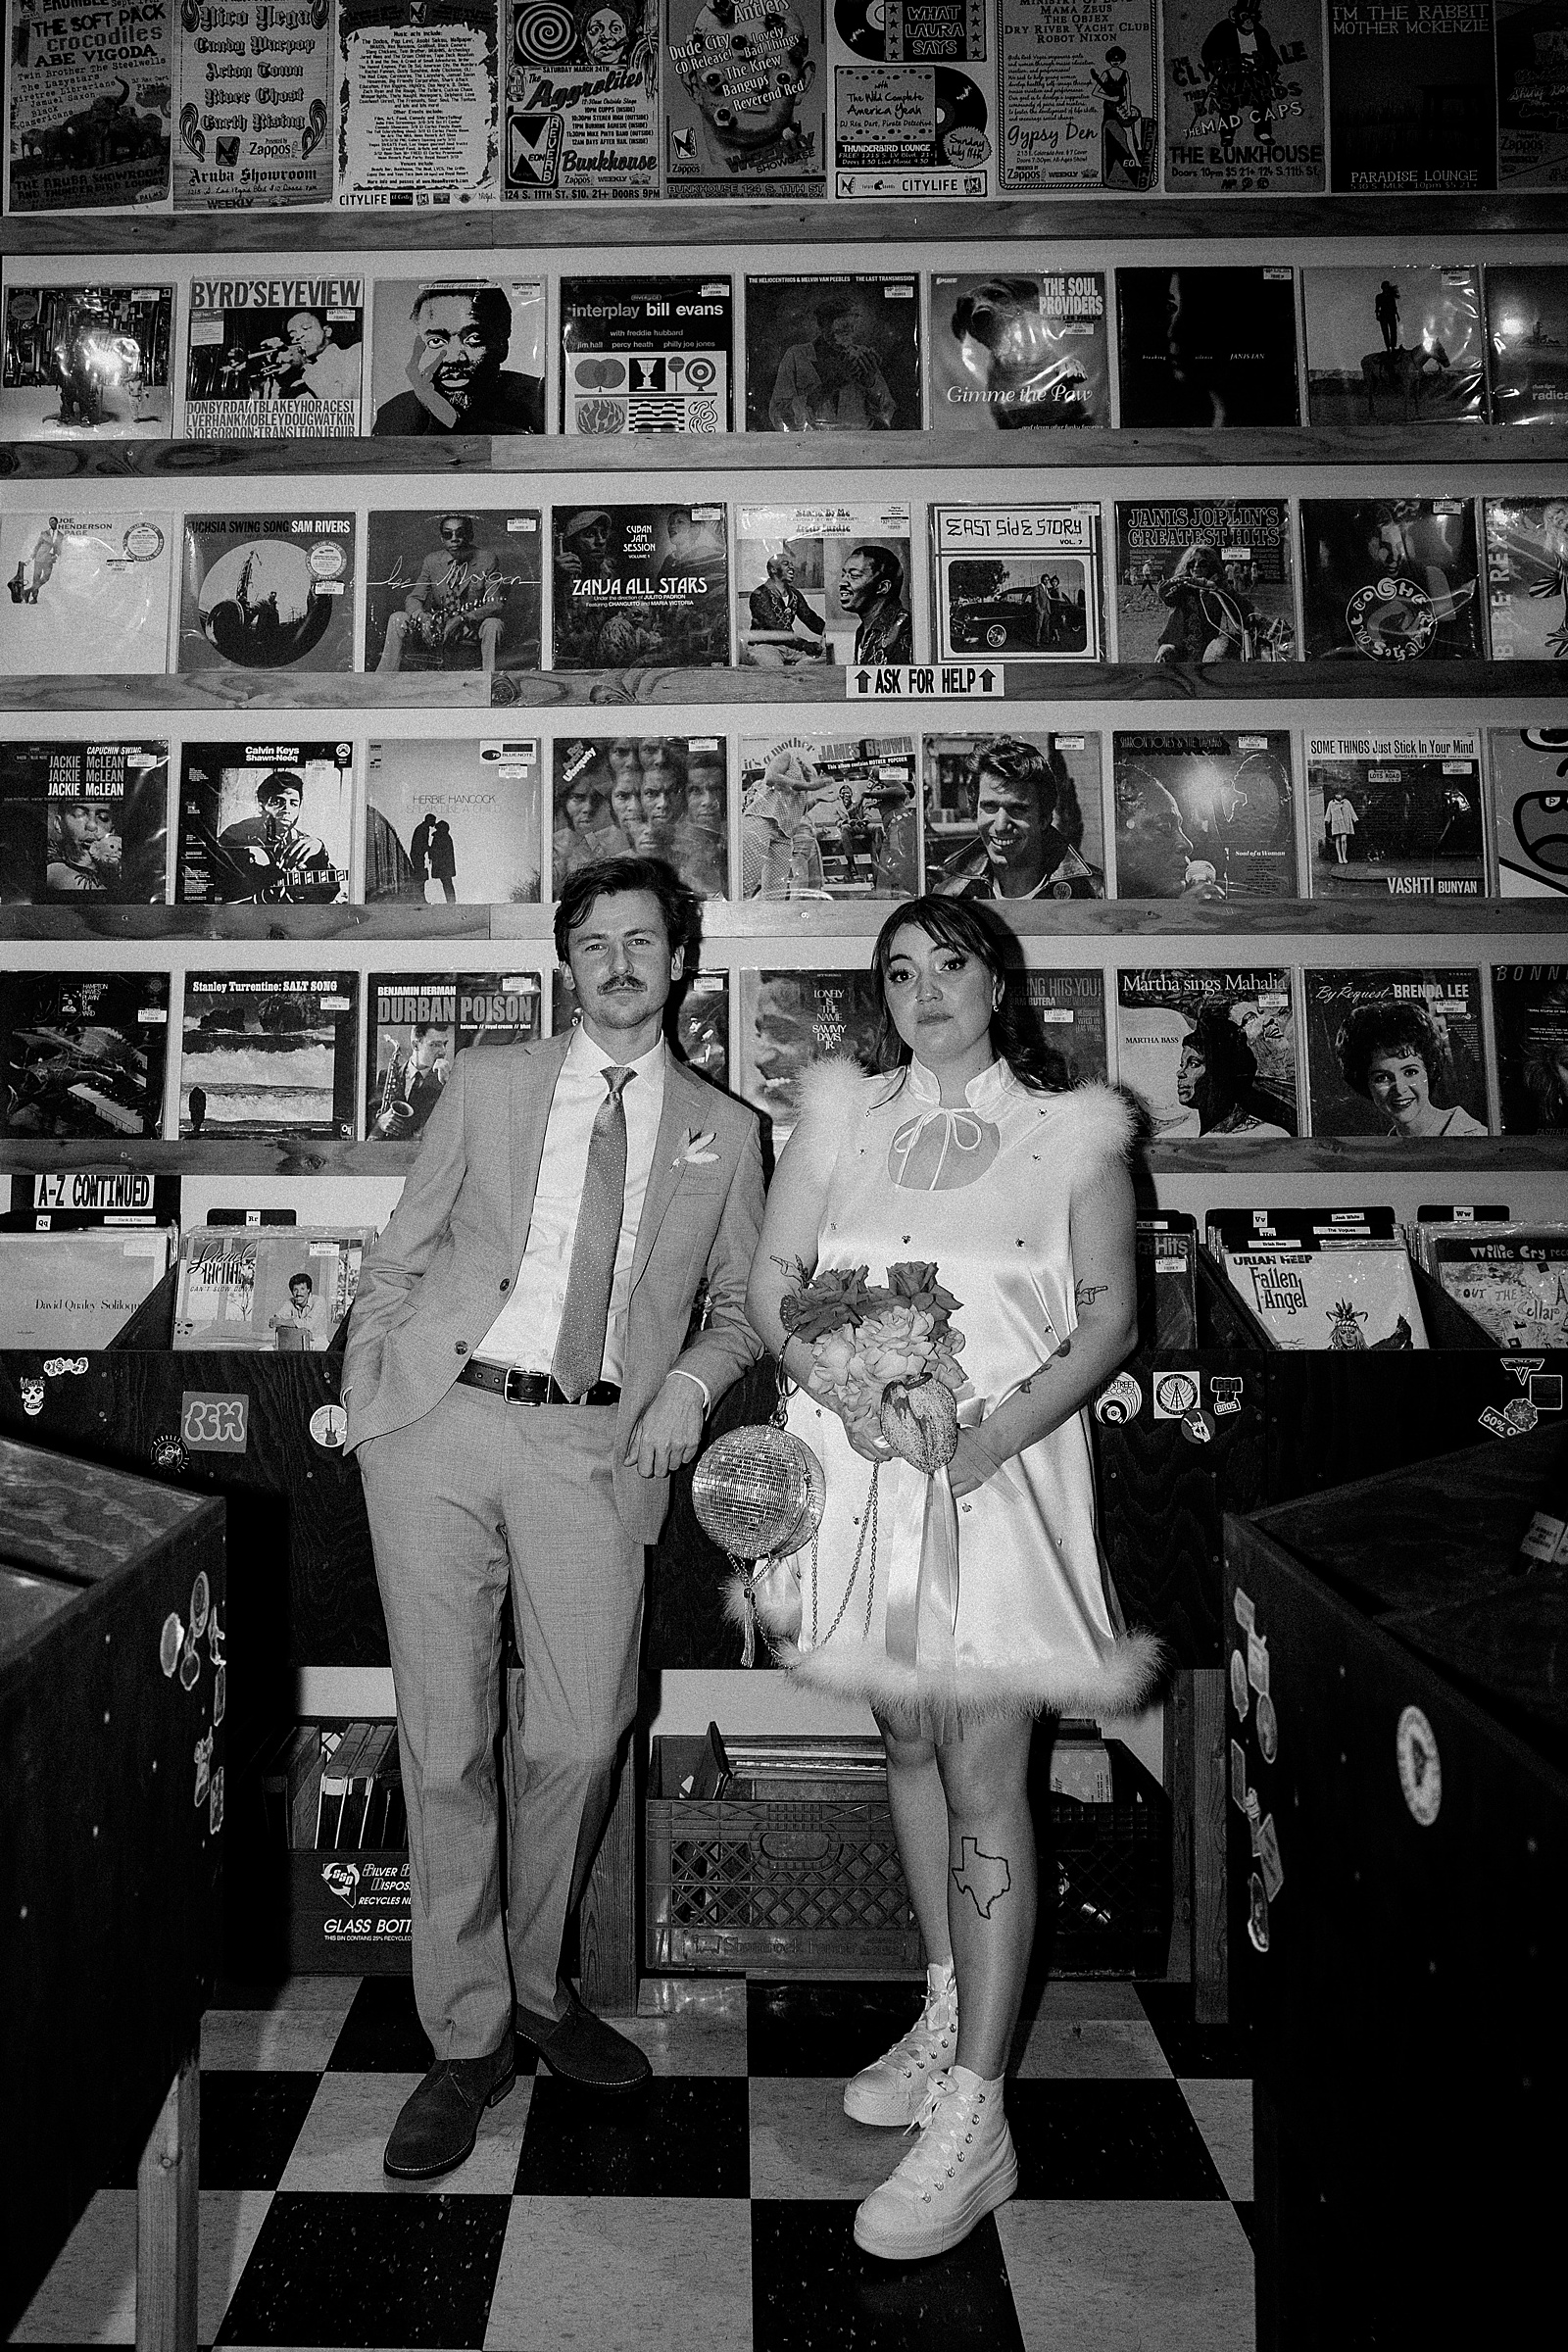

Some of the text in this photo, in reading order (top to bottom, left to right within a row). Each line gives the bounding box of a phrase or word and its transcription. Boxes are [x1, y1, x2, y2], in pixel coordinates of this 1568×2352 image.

[31, 3, 166, 37] THE SOFT PACK
[734, 0, 790, 24] Antlers
[907, 5, 961, 21] WHAT
[1332, 4, 1490, 21] I'M THE RABBIT
[752, 26, 784, 44] Lovely
[905, 23, 965, 38] LAURA
[1004, 23, 1150, 34] DRY RIVER YACHT CLUB
[1333, 21, 1399, 35] MOTHER
[47, 25, 163, 52] crocodiles
[744, 34, 800, 58] Bad Things
[1037, 33, 1117, 43] ROBOT NIXON
[668, 33, 730, 61] Dude City
[912, 40, 957, 55] SAYS
[34, 44, 158, 68] ABE VIGODA
[674, 62, 689, 74] CD
[725, 55, 782, 80] The Knew
[722, 74, 769, 97] Bangups
[733, 80, 805, 112] Reverend Red
[847, 90, 924, 104] The Wild Complete
[847, 103, 921, 120] America Yeah
[1200, 101, 1303, 135] MAD CAPS
[949, 133, 984, 152] Sunday
[1007, 122, 1098, 149] Gypsy Den
[249, 142, 291, 158] Zappos
[1169, 145, 1323, 165] THE BUNKHOUSE
[562, 149, 658, 172] Bunkhouse
[756, 149, 815, 173] SHOWCASE
[189, 169, 317, 186] Aruba Showroom
[1350, 170, 1478, 182] PARADISE LOUNGE
[902, 179, 957, 191] CITYLIFE
[339, 194, 387, 206] CITYLIFE
[504, 190, 518, 200] 124
[190, 280, 362, 308] BYRD'SEYEVIEW
[1043, 277, 1098, 296] THE SOUL
[572, 303, 724, 319] interplay bill evans
[1039, 296, 1103, 315] PROVIDERS
[947, 383, 1093, 403] Gimme the Paw
[1128, 507, 1280, 527] JANIS JOPLIN'S
[228, 519, 351, 533] SWING SONG SAM RIVERS
[946, 517, 1082, 537] EAST STORY
[1128, 527, 1281, 547] GREATEST HITS
[572, 577, 708, 596] ZANJA ALL STARS
[874, 667, 976, 694] ASK FOR HELP
[245, 746, 300, 757] Calvin Keys
[1310, 740, 1474, 754] SOME THINGS Just Stick In Your Mind
[49, 756, 80, 768] JACKIE
[49, 769, 80, 782] JACKIE
[48, 783, 80, 796] JACKIE
[1387, 877, 1477, 894] VASHTI BUNYAN
[193, 981, 338, 993] Stanley Turrentine: SALT SONG
[377, 986, 457, 996] BENJAMIN HERMAN
[1123, 972, 1288, 996] Martha sings Mahalia
[1394, 984, 1469, 998] BRENDA LEE
[377, 996, 532, 1023] DURBAN POISON
[1028, 997, 1055, 1005] BUTERA
[811, 1024, 847, 1034] SAMMY
[38, 1175, 150, 1207] A-Z CONTINUED
[38, 1219, 49, 1229] Qq
[1155, 1237, 1189, 1255] Hits
[1470, 1245, 1545, 1259] Willie Cry
[1233, 1254, 1313, 1265] URIAH HEEP
[1262, 1279, 1308, 1314] Angel
[1495, 1289, 1517, 1300] THE
[35, 1298, 62, 1310] David
[1517, 1300, 1559, 1319] Cellar
[1216, 1402, 1237, 1412] BROS
[1483, 1413, 1504, 1432] 60%
[324, 1919, 371, 1934] GLASS
